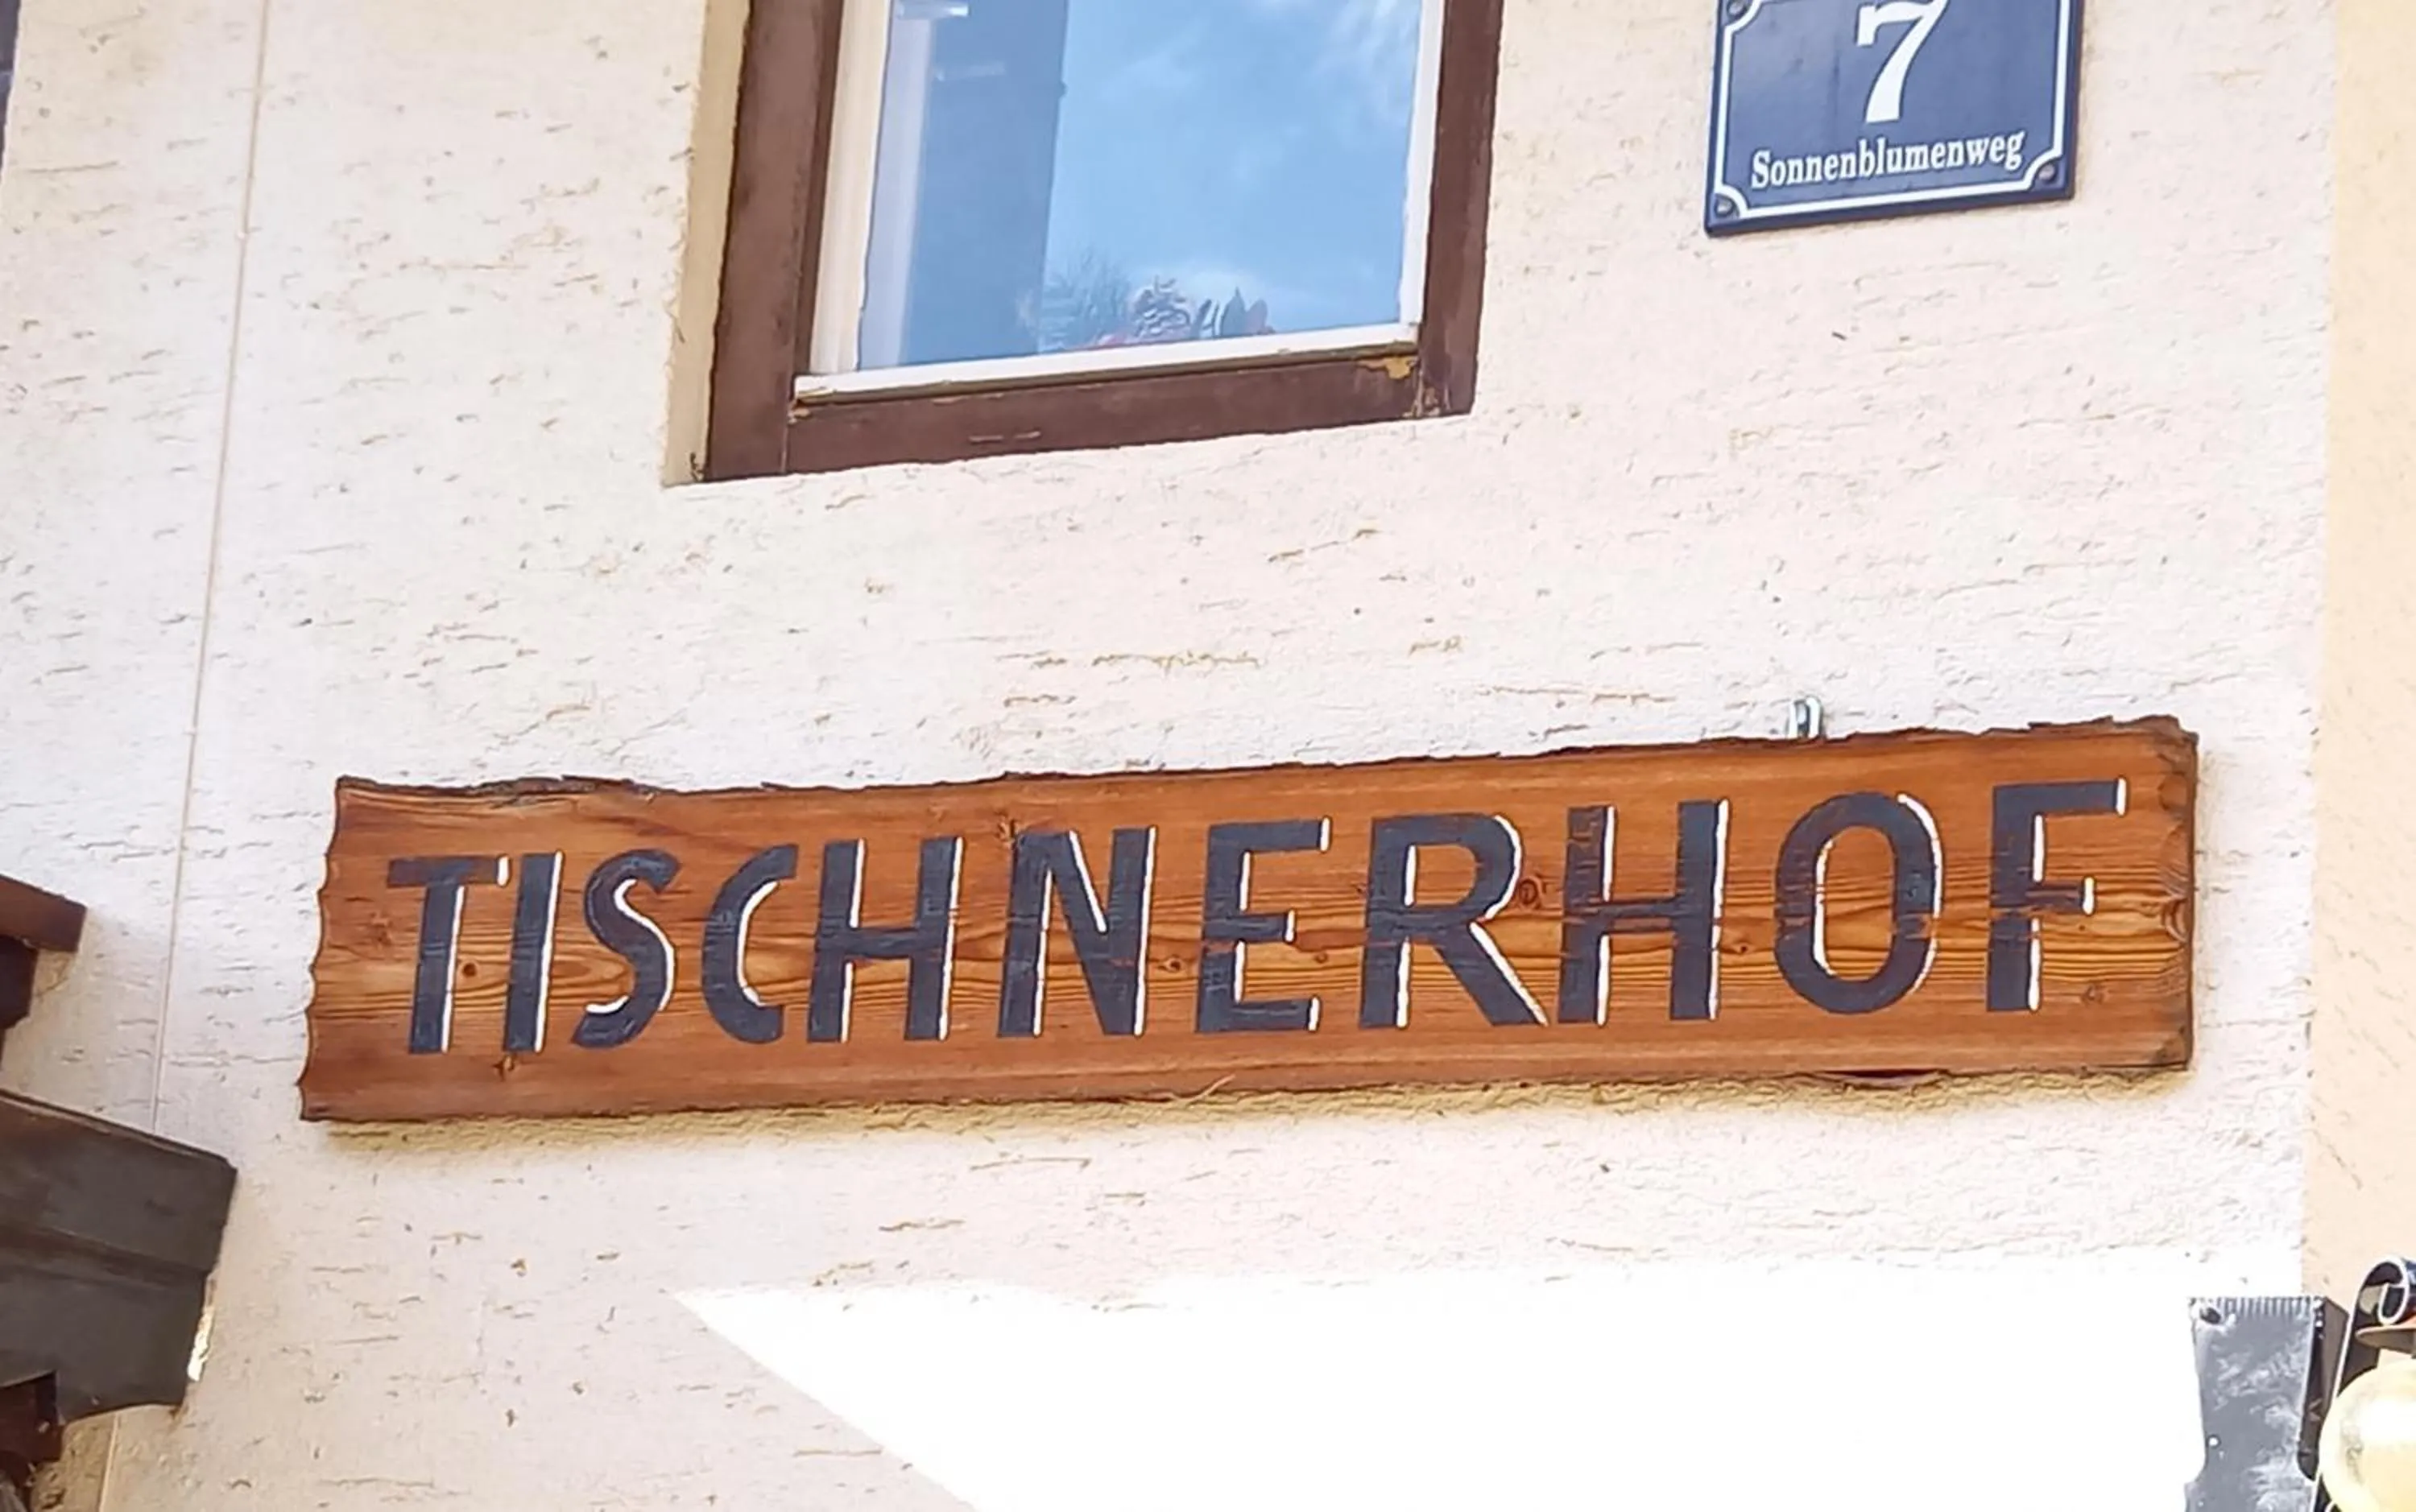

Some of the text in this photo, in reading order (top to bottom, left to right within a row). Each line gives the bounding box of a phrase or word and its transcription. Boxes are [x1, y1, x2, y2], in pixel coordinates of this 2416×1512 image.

[1857, 0, 1950, 123] 7
[1751, 131, 2025, 188] Sonnenblumenweg
[388, 778, 2128, 1054] TISCHNERHOF
